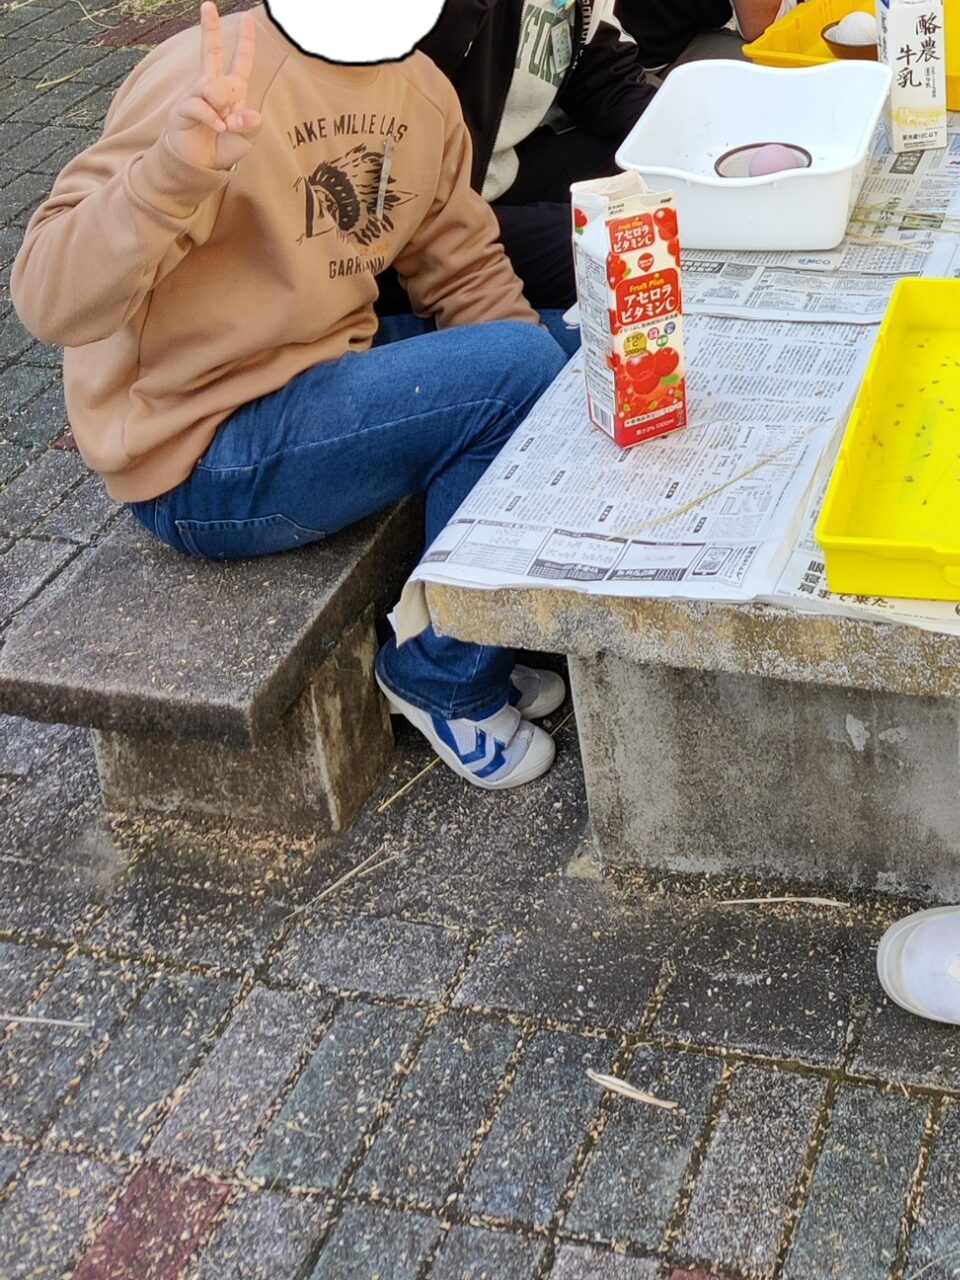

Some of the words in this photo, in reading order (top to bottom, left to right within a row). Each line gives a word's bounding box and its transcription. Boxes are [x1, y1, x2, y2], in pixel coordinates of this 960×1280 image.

[915, 12, 942, 63] 酪農
[896, 44, 922, 88] 牛乳
[287, 117, 327, 150] LAKE
[334, 114, 376, 136] MILLE
[613, 234, 652, 253] ビタミンC
[614, 224, 649, 240] アセロラ
[624, 284, 672, 307] アセロラ
[629, 282, 648, 292] Fruit
[649, 277, 664, 288] Plus
[621, 297, 676, 323] ビタミンC
